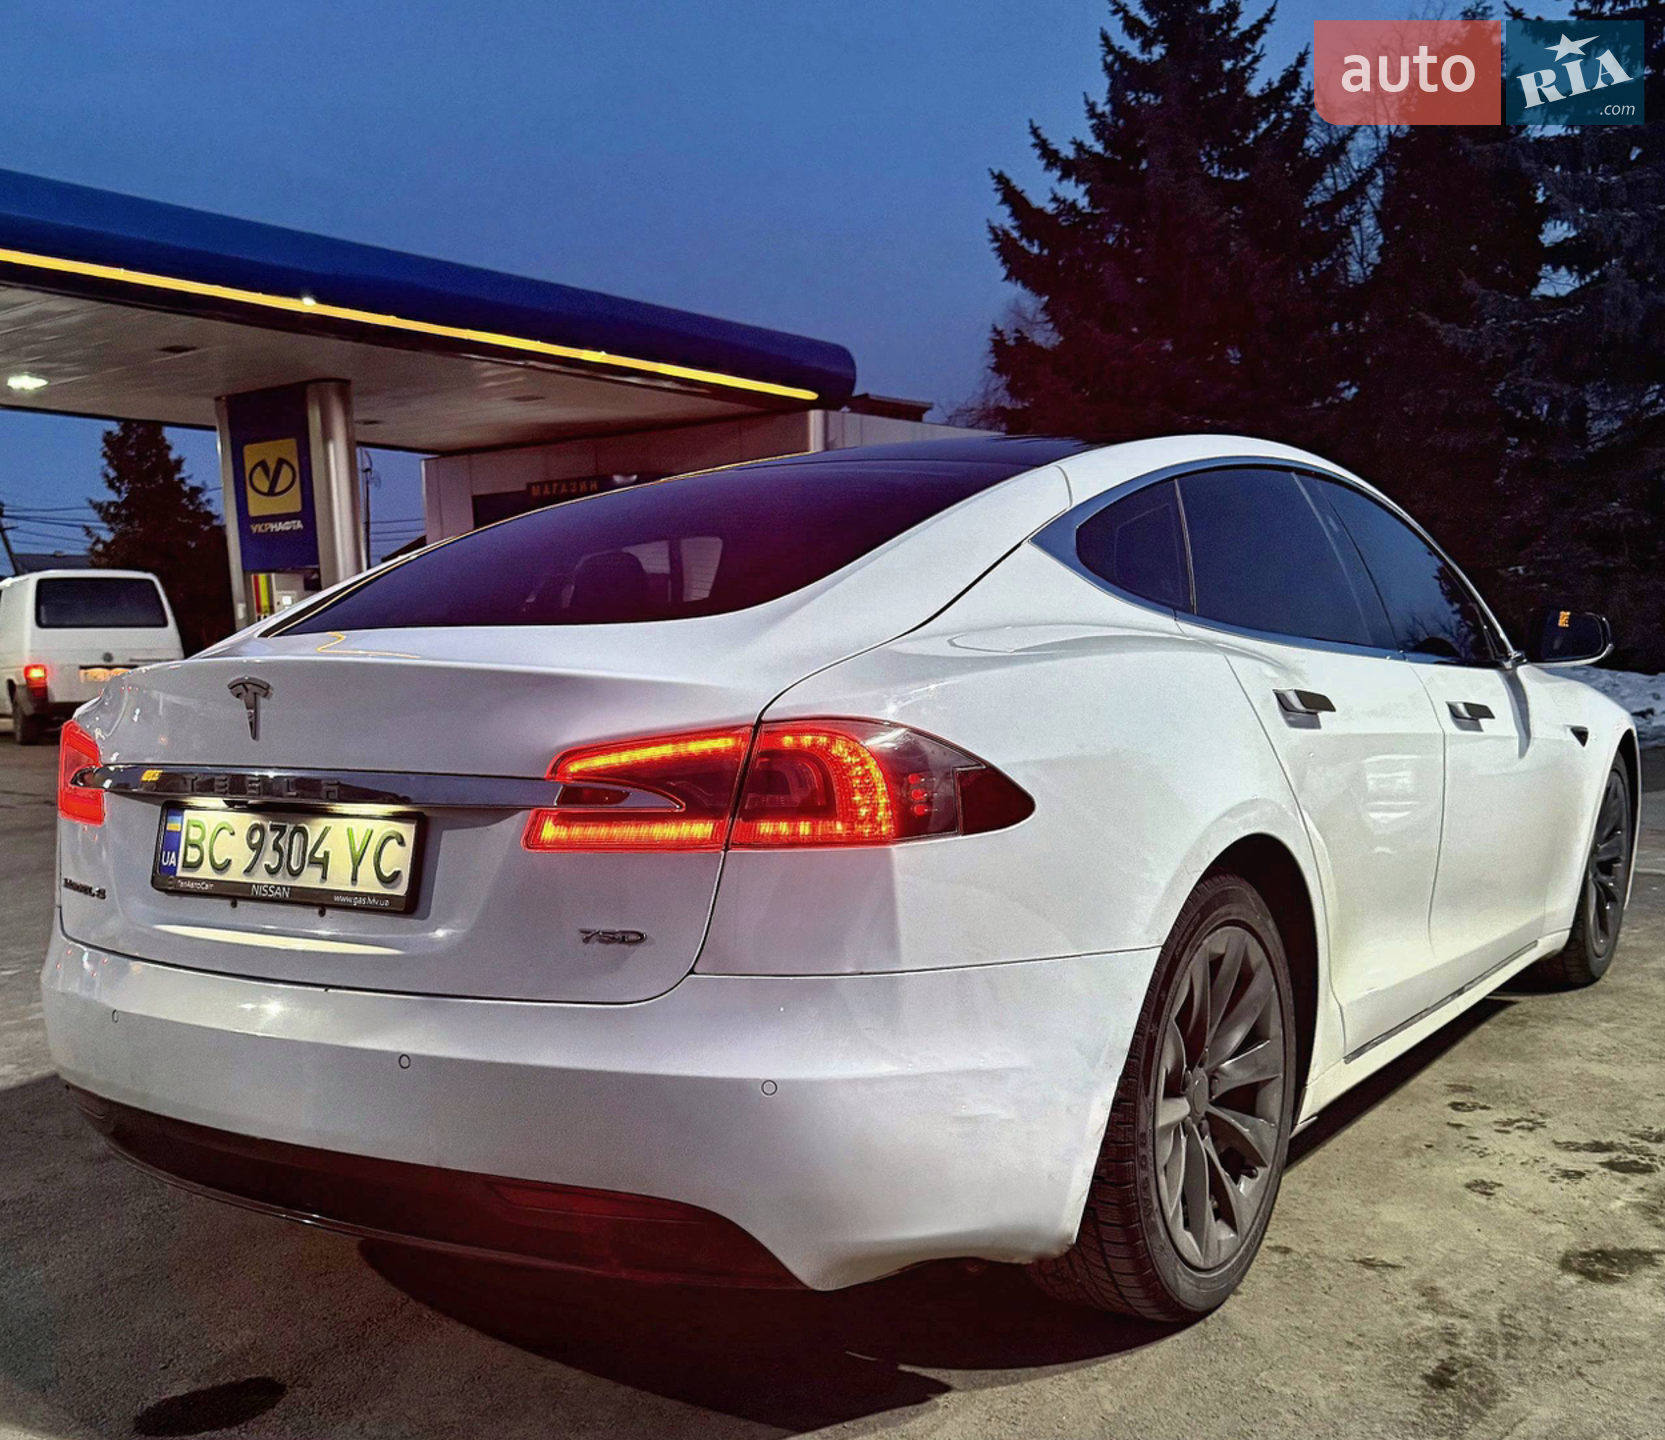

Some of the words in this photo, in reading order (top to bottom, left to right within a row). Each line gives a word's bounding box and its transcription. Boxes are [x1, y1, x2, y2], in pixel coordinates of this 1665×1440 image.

[531, 481, 599, 497] МАГАЗИН
[250, 519, 304, 534] УКРНАФТА
[182, 773, 340, 800] TESLA
[161, 851, 178, 867] UA
[182, 819, 236, 872] BC
[243, 823, 332, 881] 9304
[347, 827, 407, 885] YC
[251, 884, 290, 898] NISSAN
